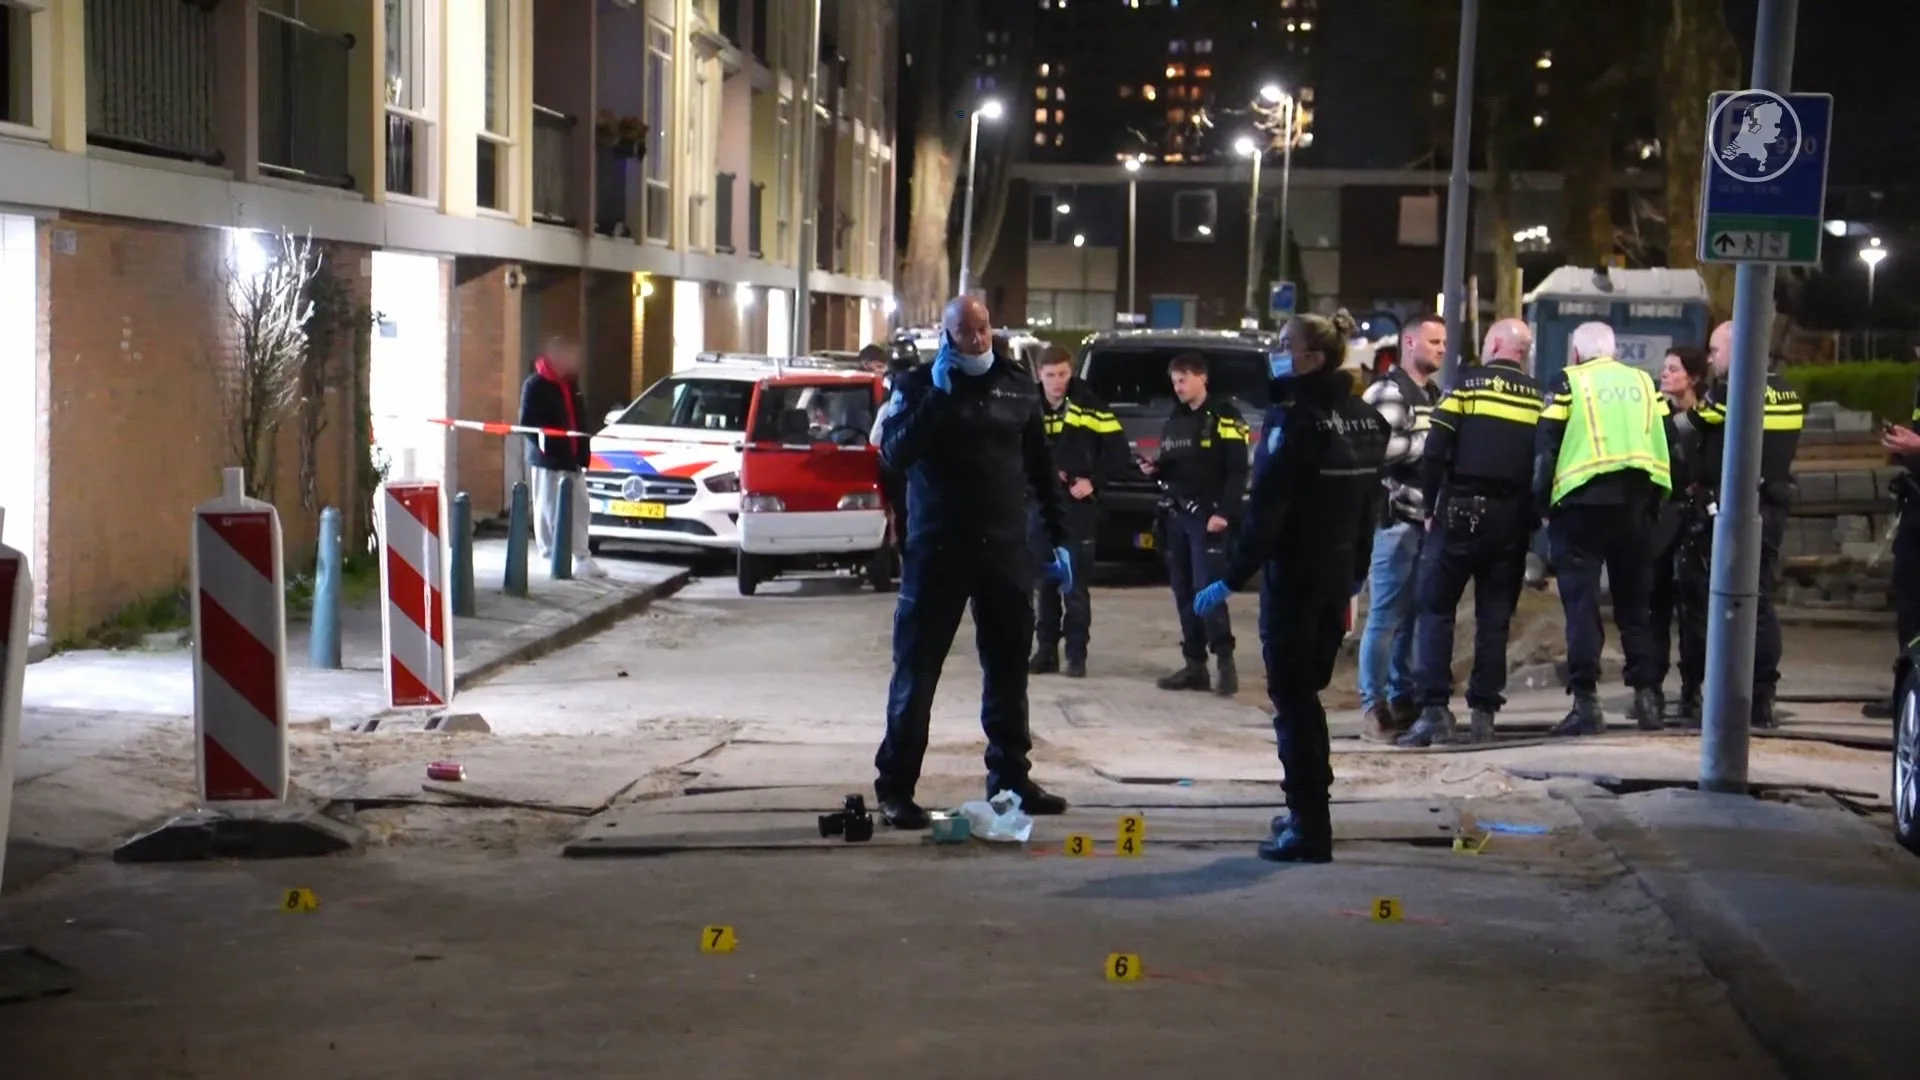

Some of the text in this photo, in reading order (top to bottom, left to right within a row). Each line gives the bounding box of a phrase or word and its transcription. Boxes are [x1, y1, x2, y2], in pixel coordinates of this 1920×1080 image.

[1615, 342, 1647, 361] XI
[1124, 818, 1136, 833] 2
[1071, 836, 1083, 854] 3
[1122, 837, 1134, 854] 4
[288, 890, 300, 909] 8
[1379, 900, 1391, 918] 5
[711, 928, 724, 948] 7
[1115, 956, 1128, 977] 6
